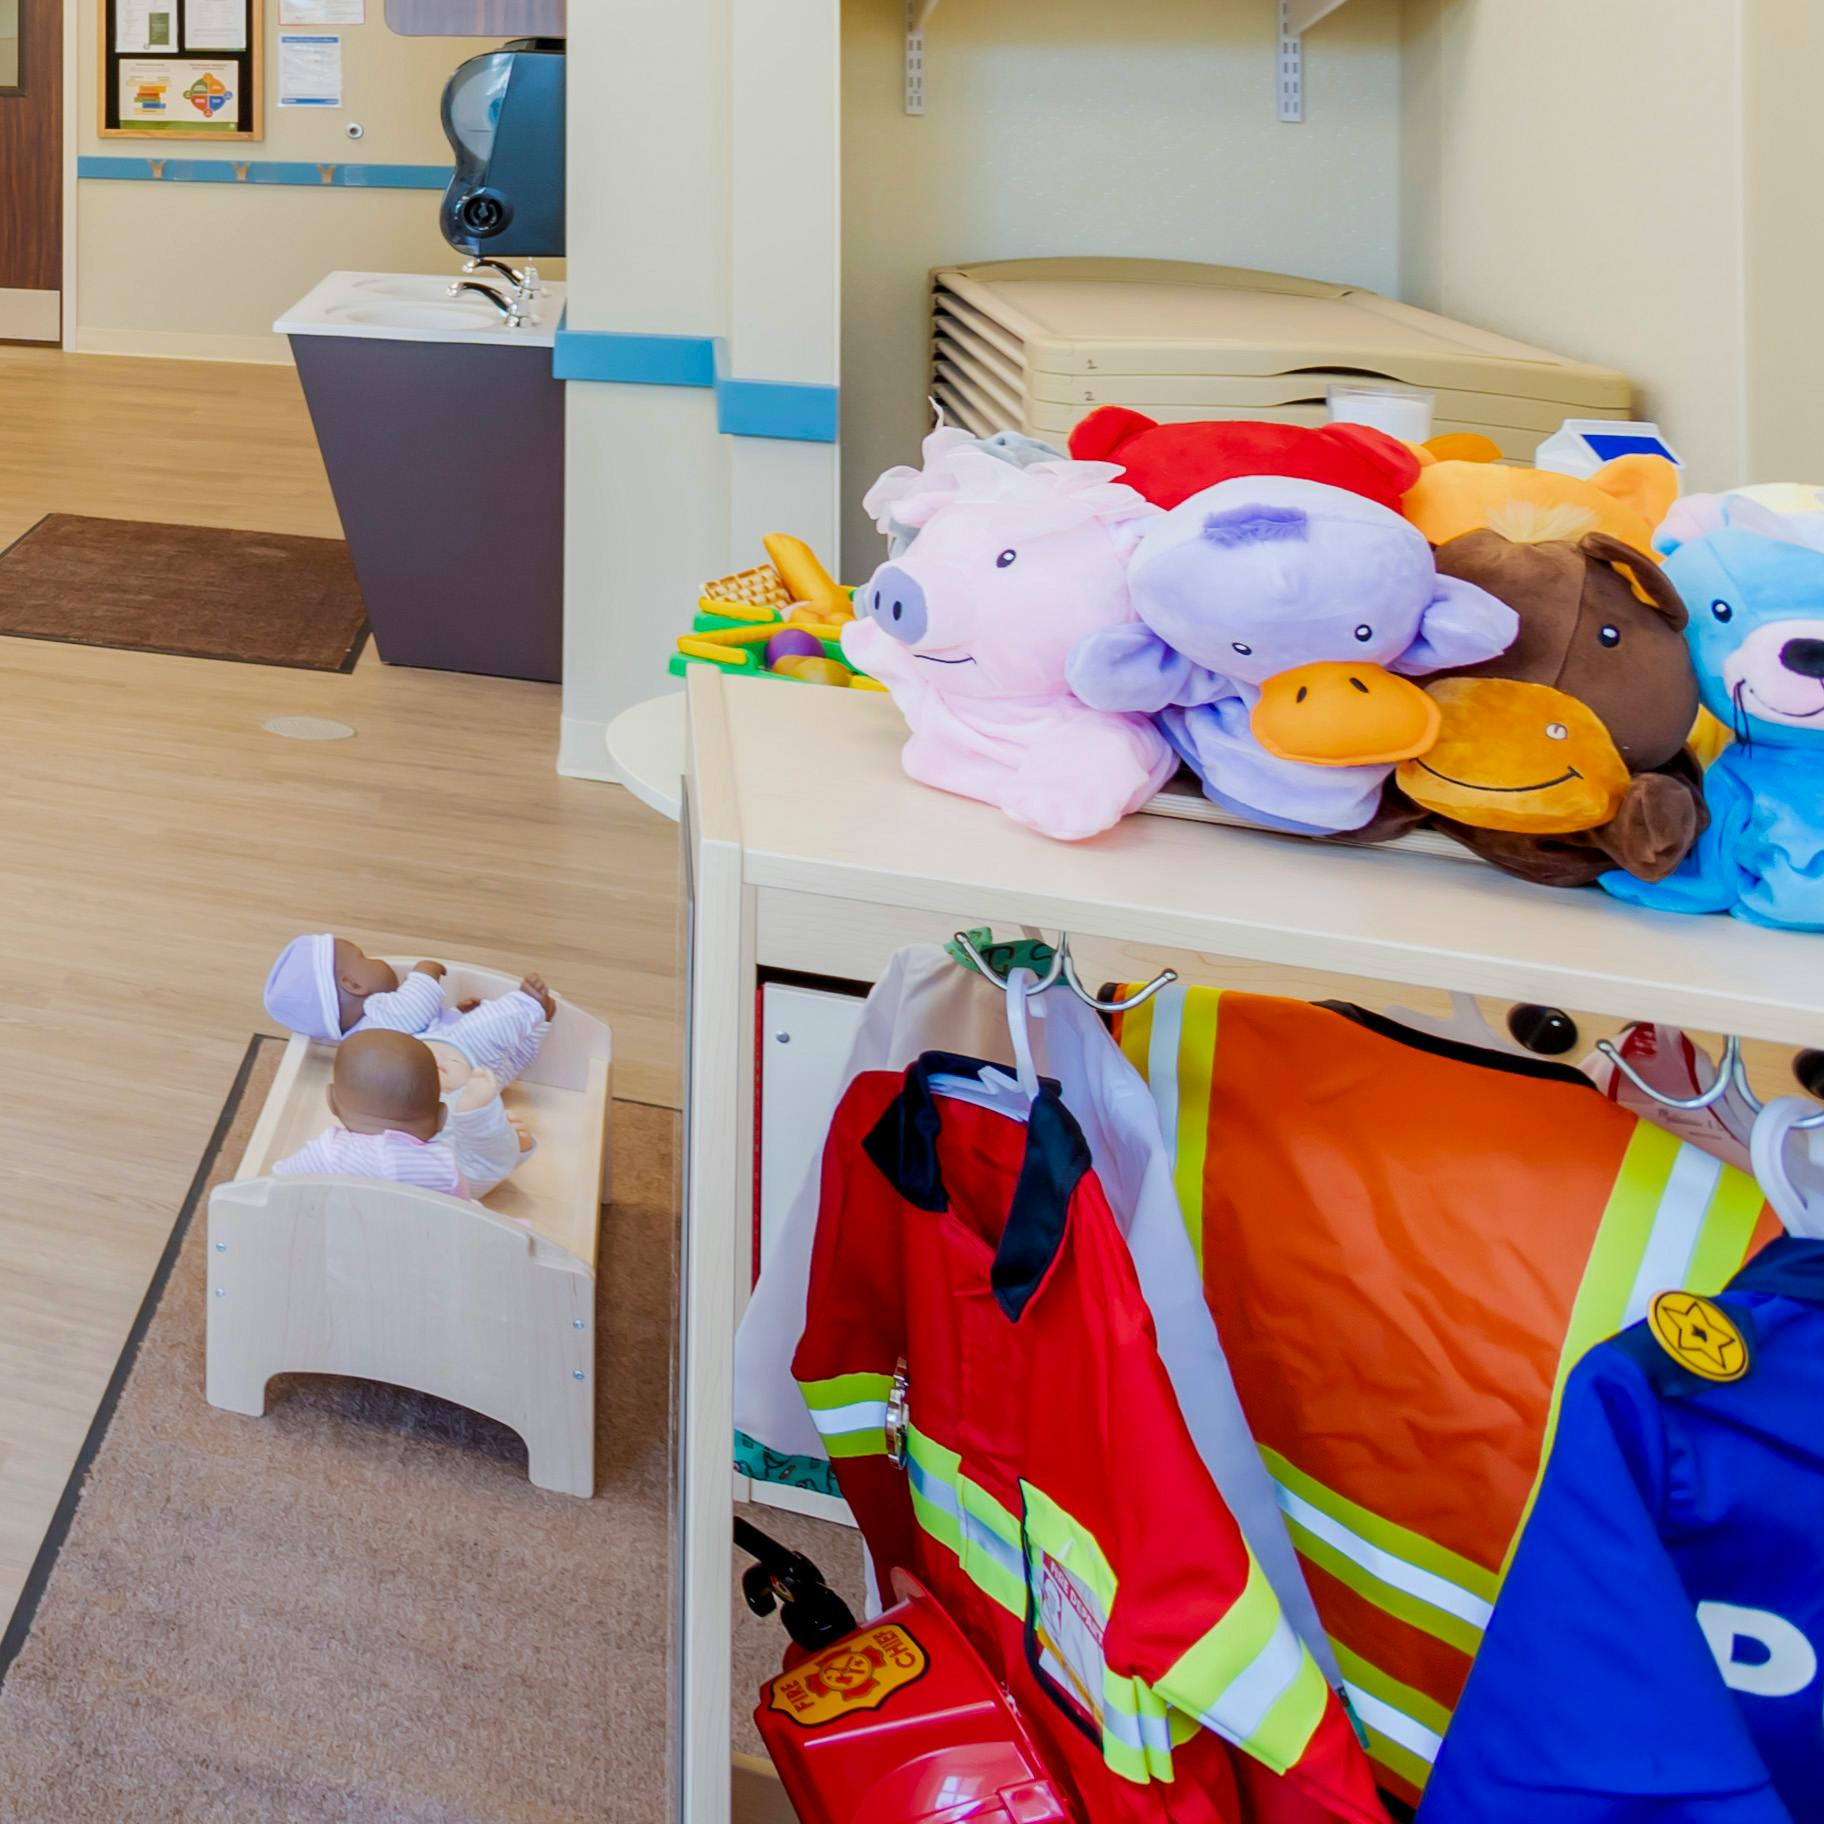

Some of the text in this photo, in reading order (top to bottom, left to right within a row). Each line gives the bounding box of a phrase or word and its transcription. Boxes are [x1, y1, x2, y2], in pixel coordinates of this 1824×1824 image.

[1087, 359, 1097, 370] 1
[1084, 390, 1095, 401] 2
[872, 1629, 917, 1669] CHIEF
[779, 1678, 816, 1714] FIRE
